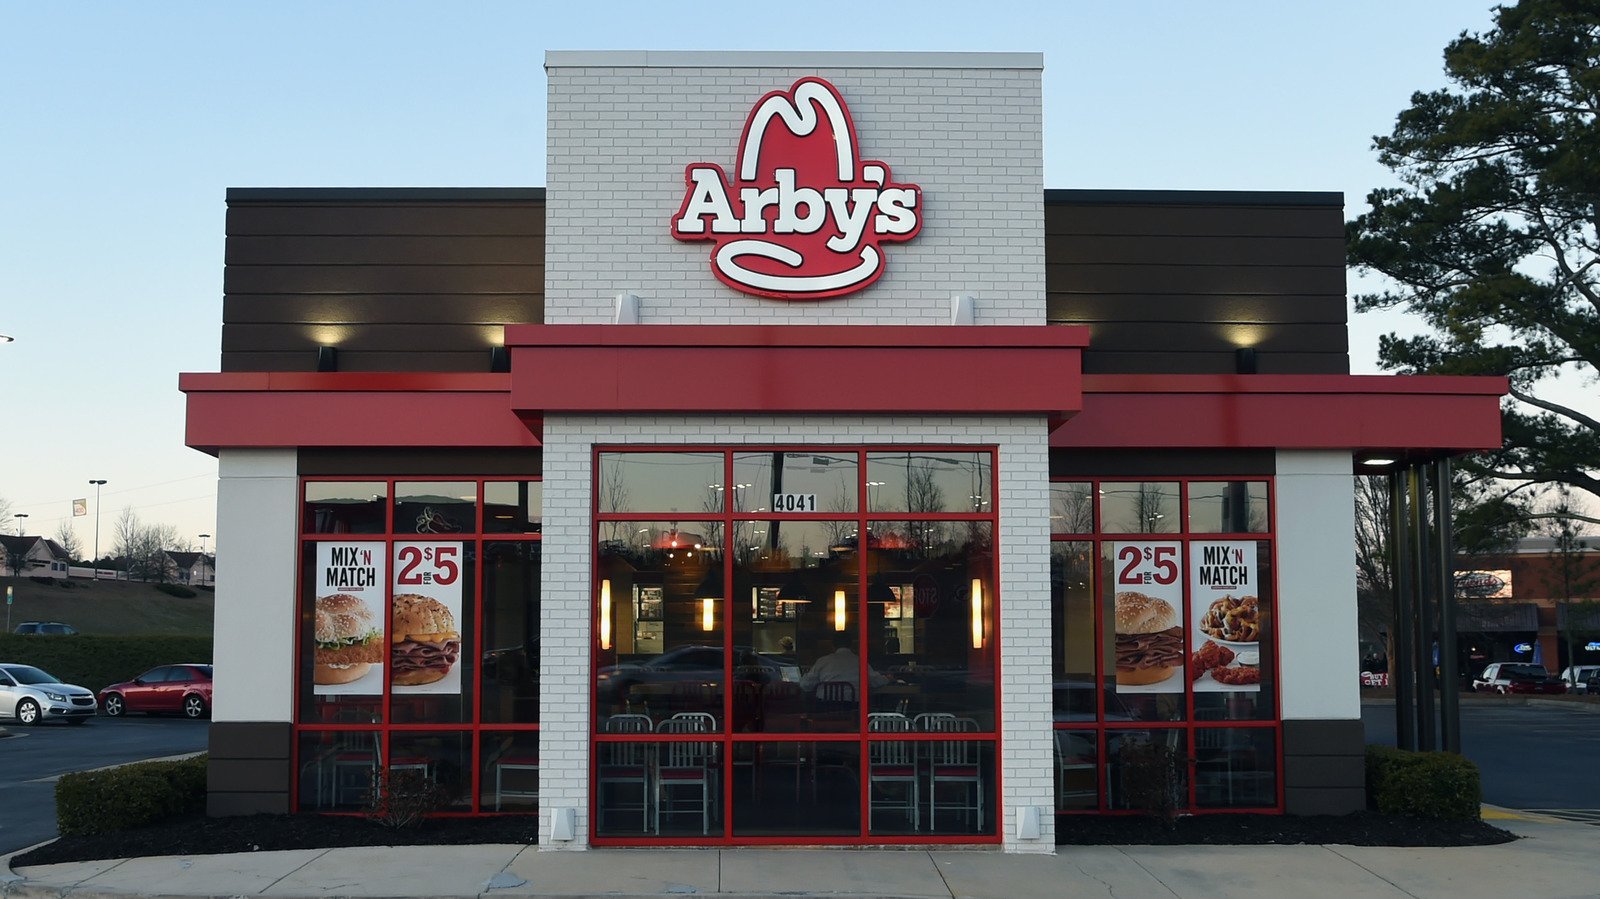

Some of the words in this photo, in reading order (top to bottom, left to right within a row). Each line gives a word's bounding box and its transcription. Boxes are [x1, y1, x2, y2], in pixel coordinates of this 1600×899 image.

[677, 165, 917, 253] Arby's
[775, 494, 815, 511] 4041
[331, 547, 359, 567] MIX
[397, 546, 422, 585] 2
[423, 571, 432, 585] FOR
[1118, 546, 1143, 585] 2
[1143, 571, 1152, 585] FOR
[1203, 546, 1230, 565] MIX
[326, 567, 376, 587] MATCH
[1199, 566, 1248, 585] MATCH
